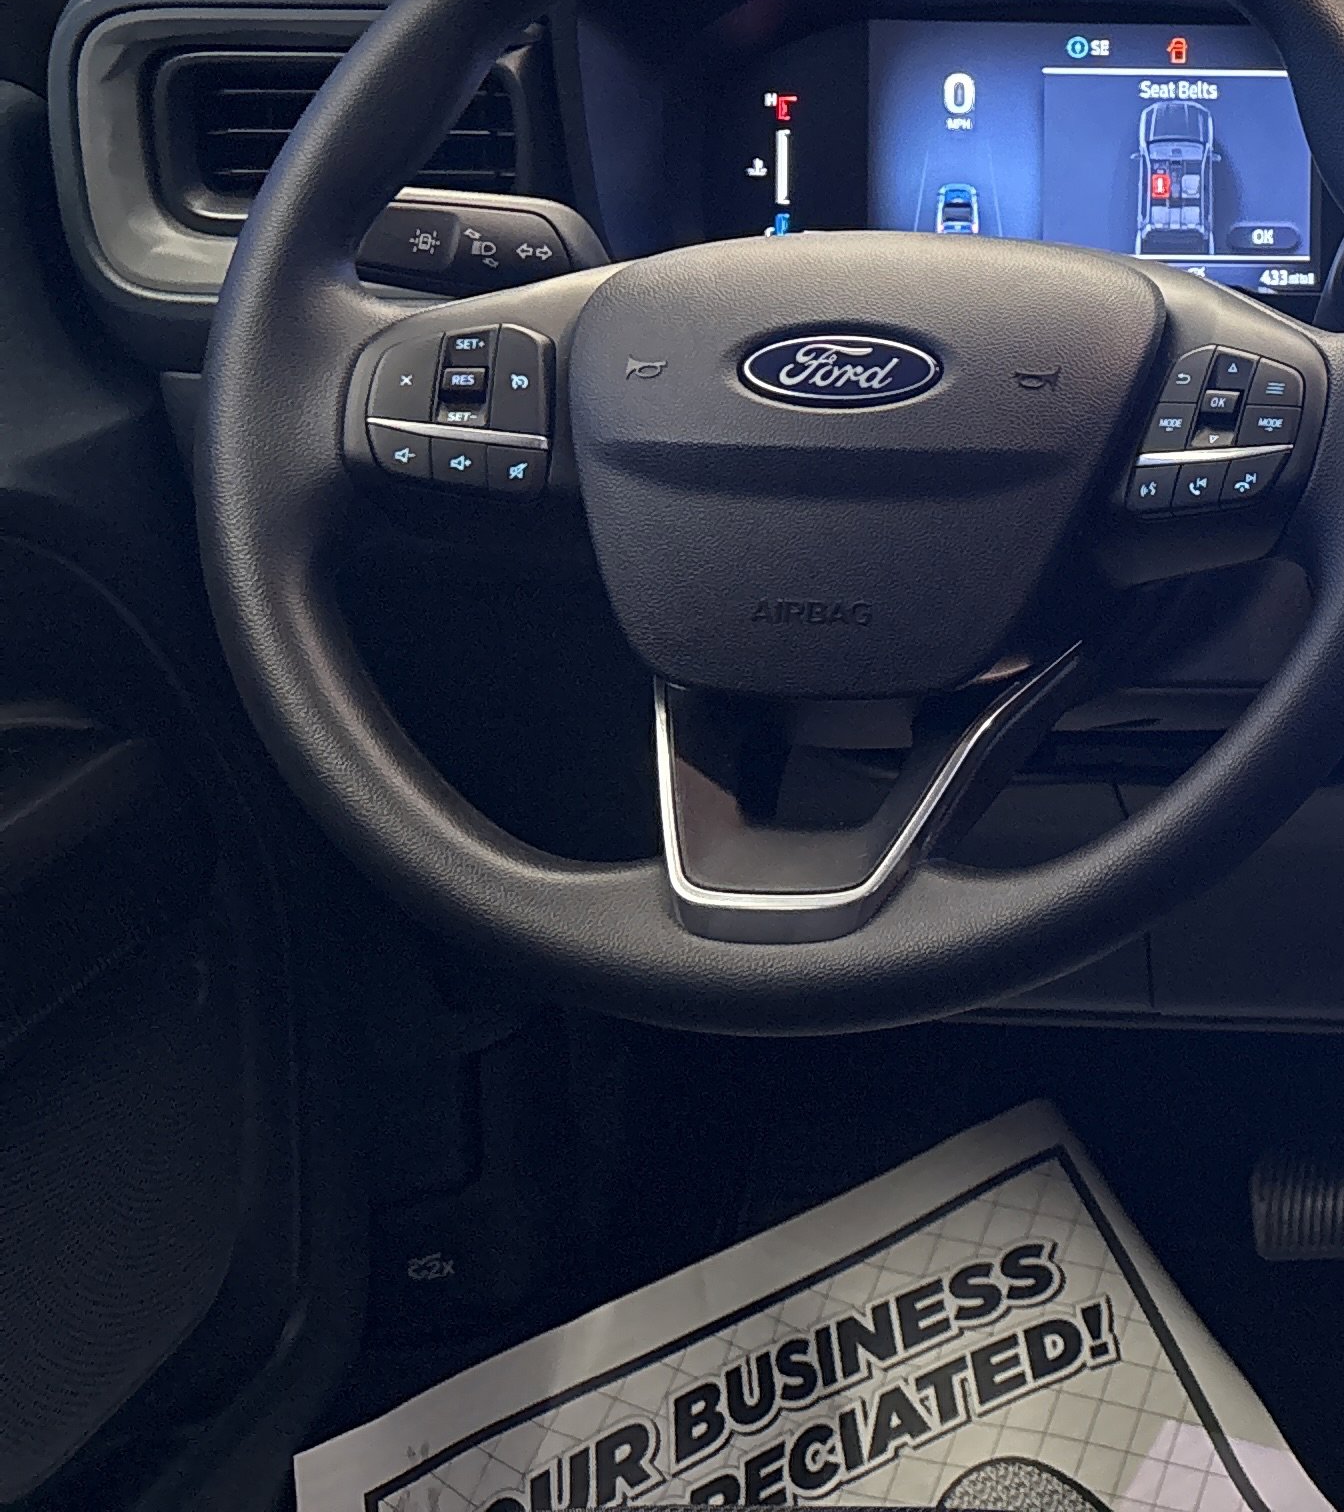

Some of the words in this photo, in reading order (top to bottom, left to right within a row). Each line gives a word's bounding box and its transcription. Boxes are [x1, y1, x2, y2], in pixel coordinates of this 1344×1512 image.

[1090, 39, 1111, 57] SE
[942, 71, 977, 115] 0
[1139, 79, 1176, 100] Seat
[1178, 79, 1218, 100] Belts
[946, 117, 974, 131] MPH
[1251, 228, 1275, 245] OK
[1260, 269, 1287, 286] 433
[779, 343, 901, 389] Ford
[451, 374, 475, 385] RES
[1210, 396, 1226, 408] OK
[1159, 418, 1183, 428] MODE
[1258, 417, 1283, 429] MODE
[752, 597, 873, 626] AIRBAG
[486, 1421, 654, 1510] UR
[673, 1241, 1061, 1465] BUSINESS
